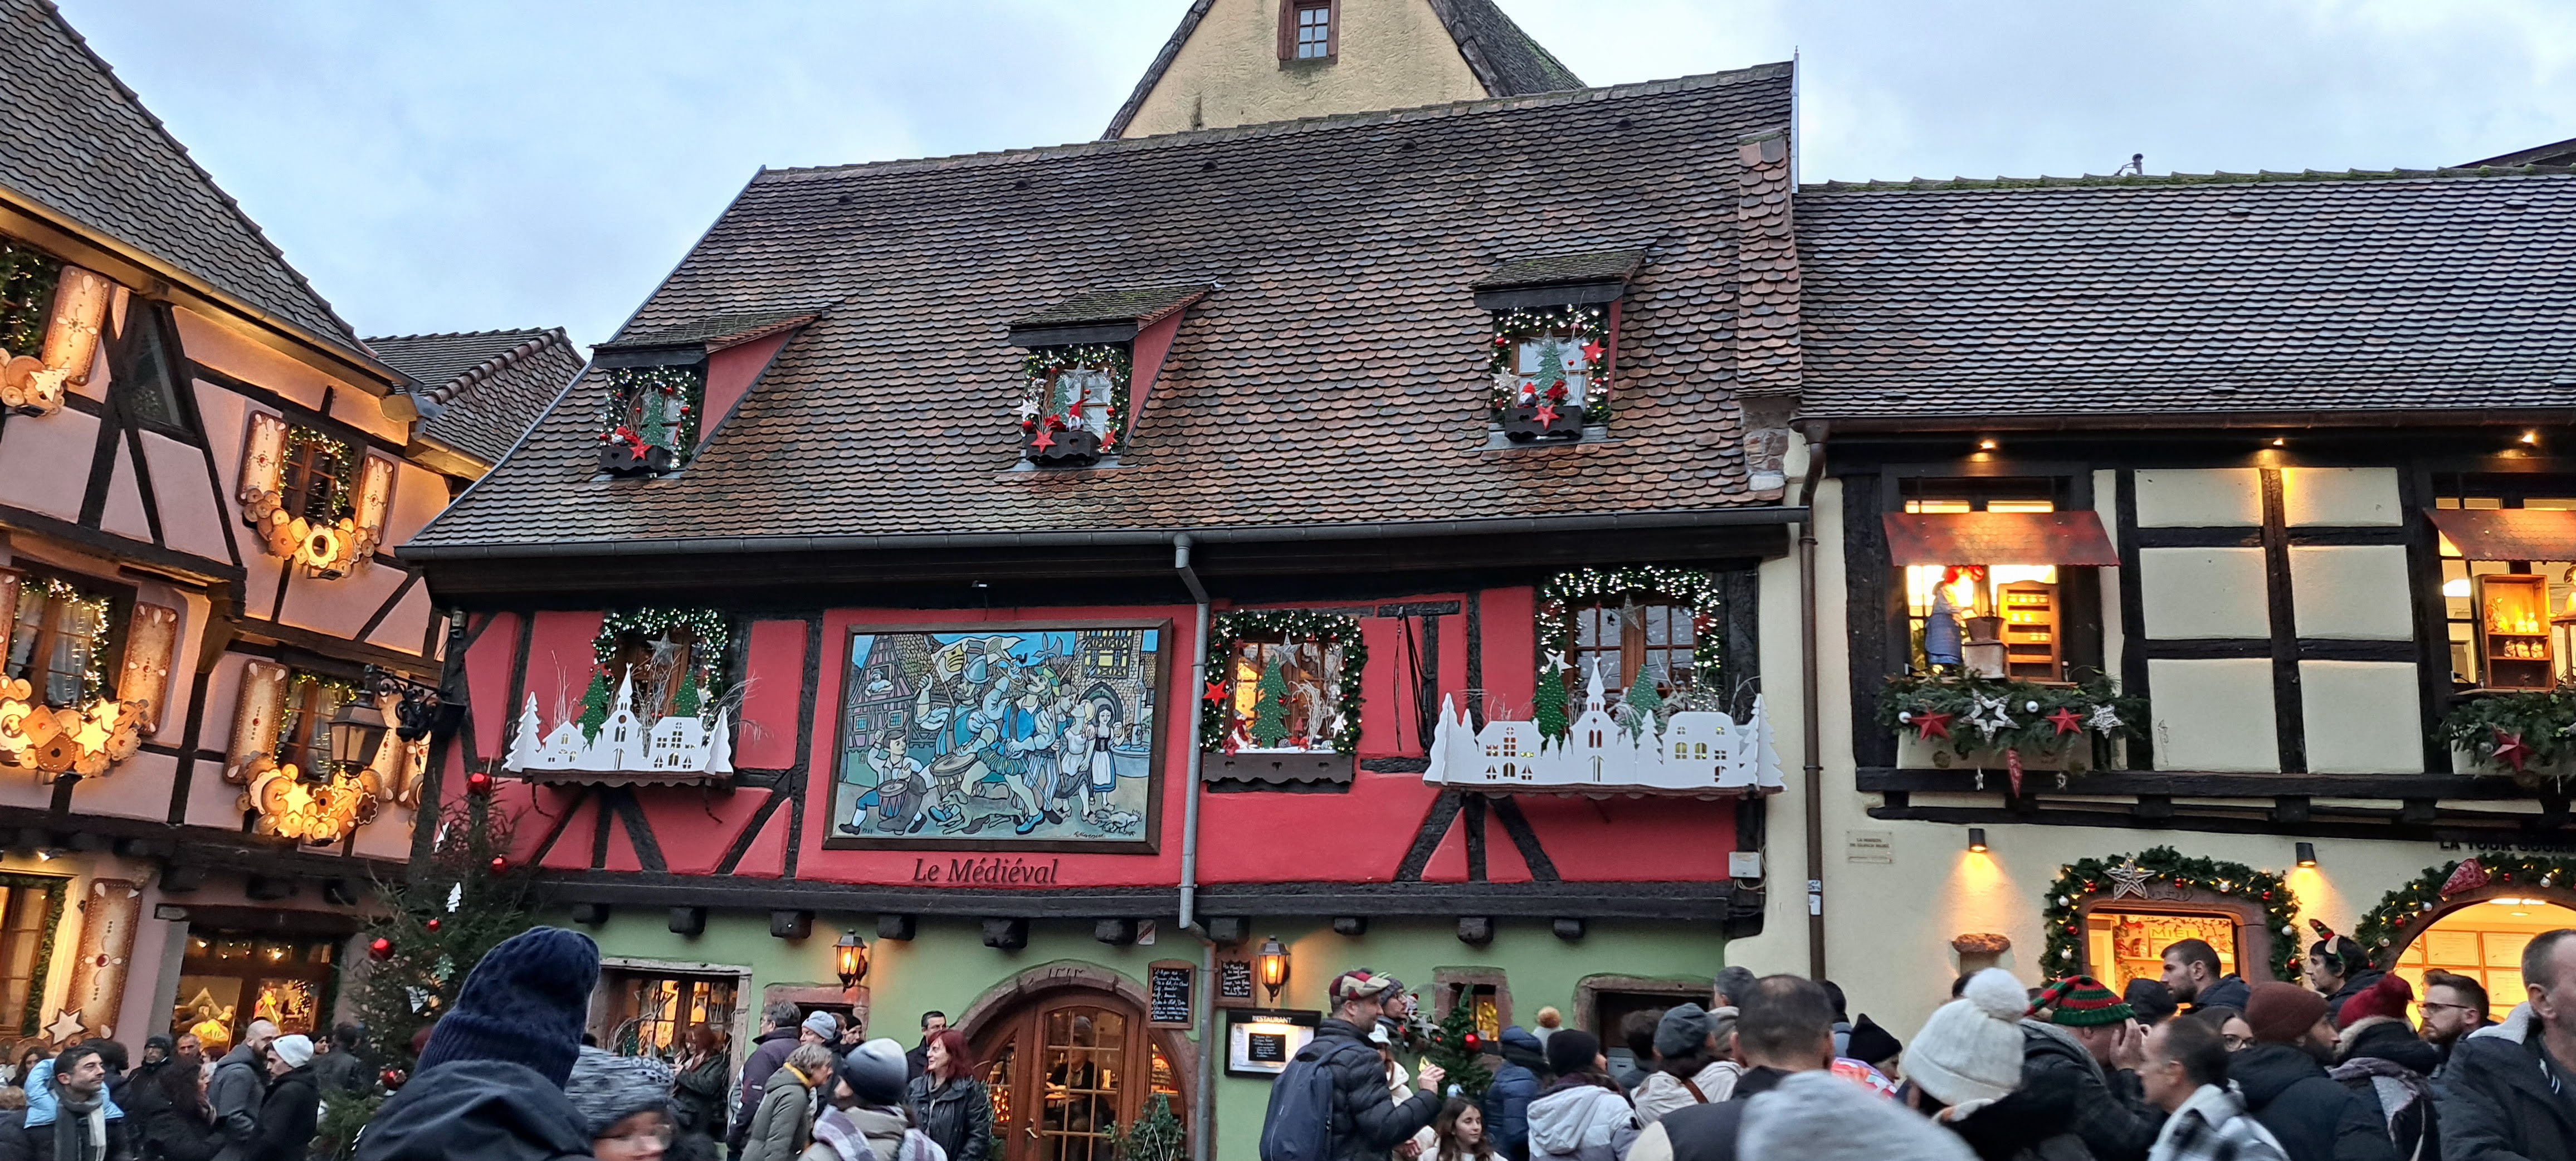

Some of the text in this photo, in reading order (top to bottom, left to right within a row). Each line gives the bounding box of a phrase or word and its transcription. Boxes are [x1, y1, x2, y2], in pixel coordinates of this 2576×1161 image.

[2440, 838, 2460, 849] LA
[913, 857, 1059, 884] Le Médiéval
[1252, 1015, 1292, 1024] RESTAURANT
